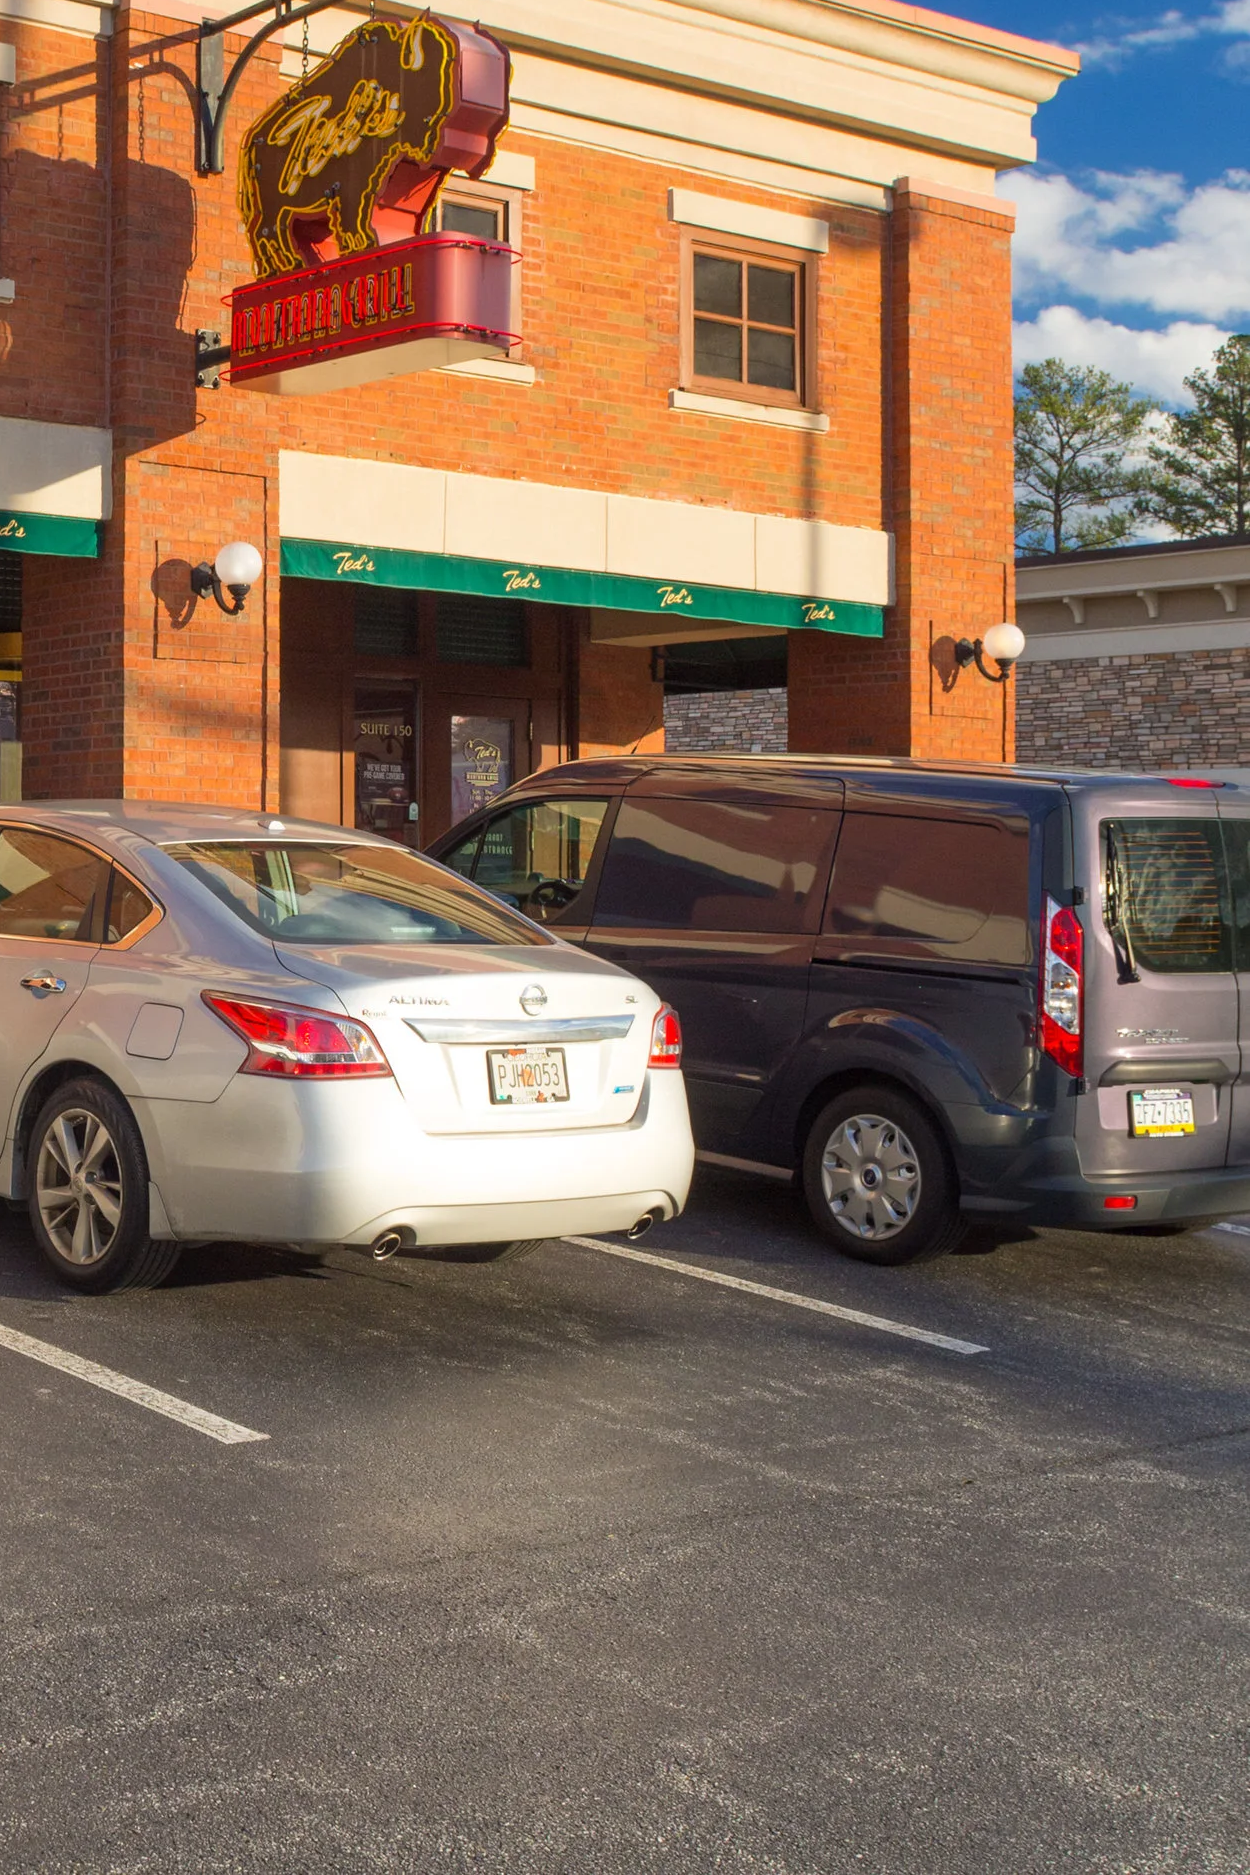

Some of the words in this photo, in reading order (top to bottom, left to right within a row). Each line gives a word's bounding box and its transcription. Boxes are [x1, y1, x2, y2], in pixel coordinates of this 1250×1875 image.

[267, 78, 406, 197] Ted's
[232, 283, 342, 358] MONTANA
[342, 263, 415, 328] GRILL
[332, 551, 375, 575] Ted's
[502, 569, 541, 592] Ted's
[656, 586, 694, 608] Ted's
[801, 603, 836, 623] Ted's
[360, 723, 390, 735] SUITE
[394, 725, 412, 736] 150
[474, 746, 496, 760] Ted's
[625, 995, 638, 1004] SL
[497, 1062, 561, 1089] PJH2053
